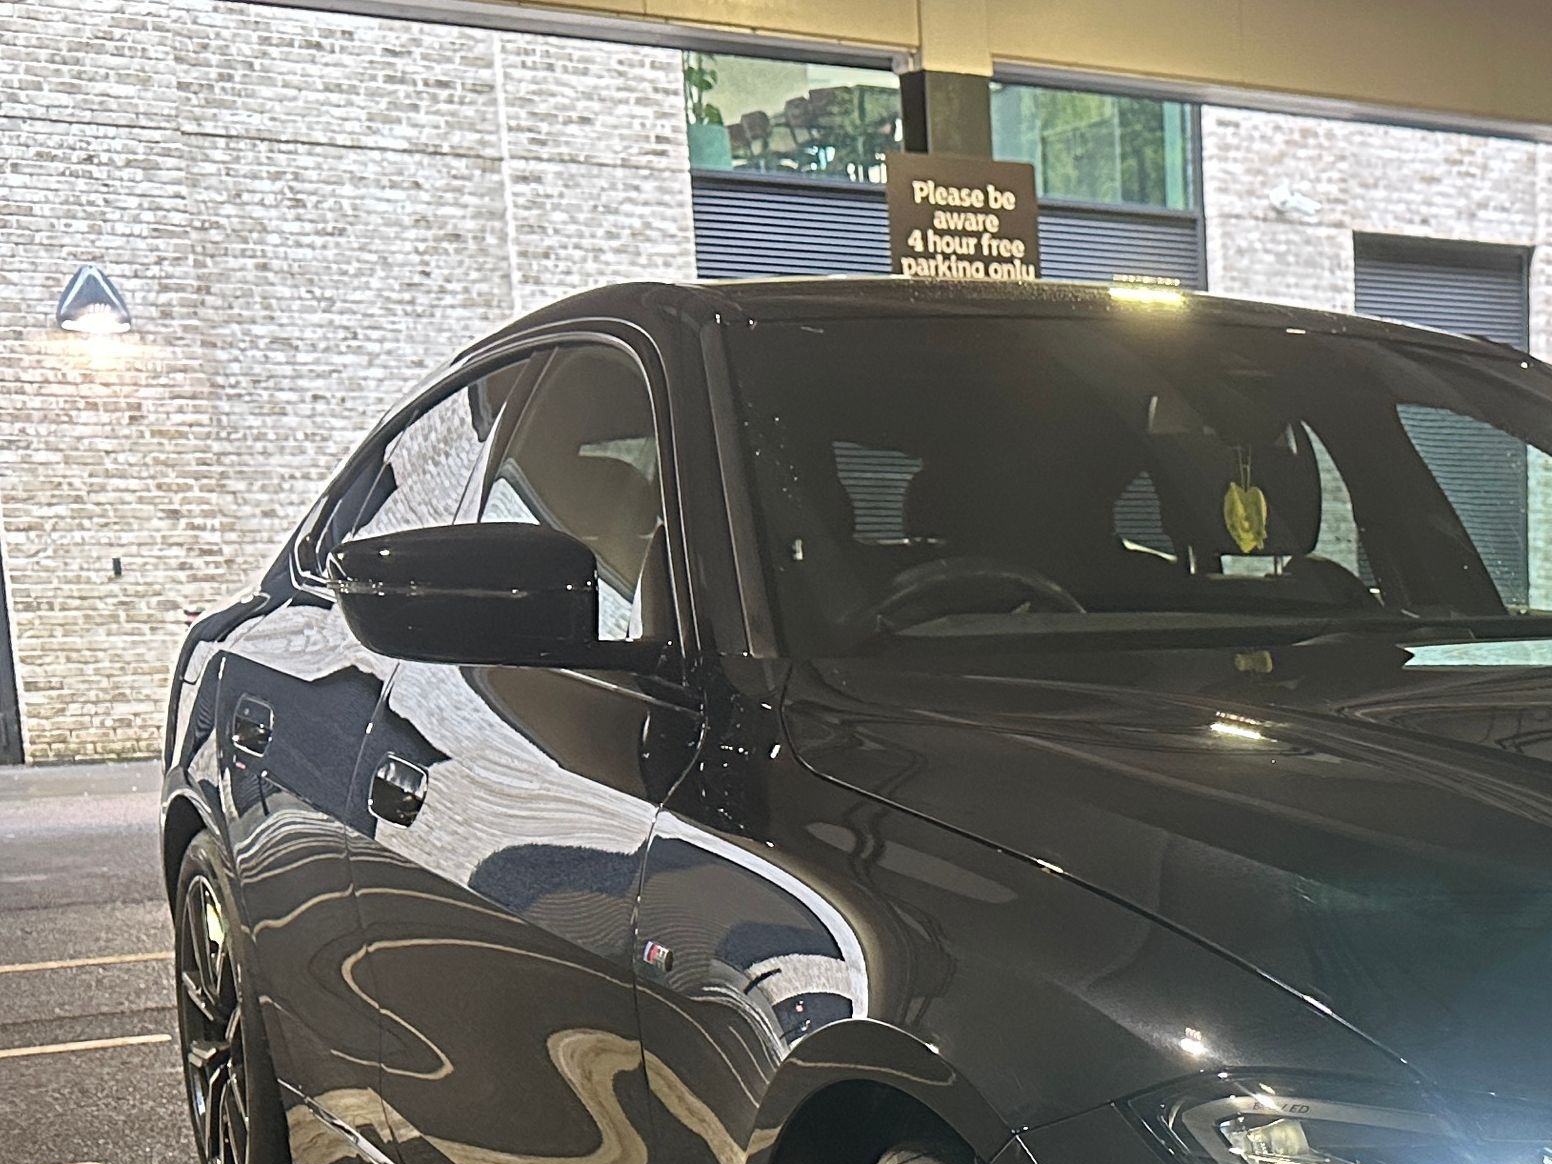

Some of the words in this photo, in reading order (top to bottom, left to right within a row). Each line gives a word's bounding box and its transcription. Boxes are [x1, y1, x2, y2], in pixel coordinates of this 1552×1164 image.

[911, 180, 985, 208] Please
[986, 184, 1016, 211] be
[933, 210, 1000, 232] aware
[907, 229, 924, 252] 4
[927, 229, 978, 255] hour
[981, 233, 1025, 258] free
